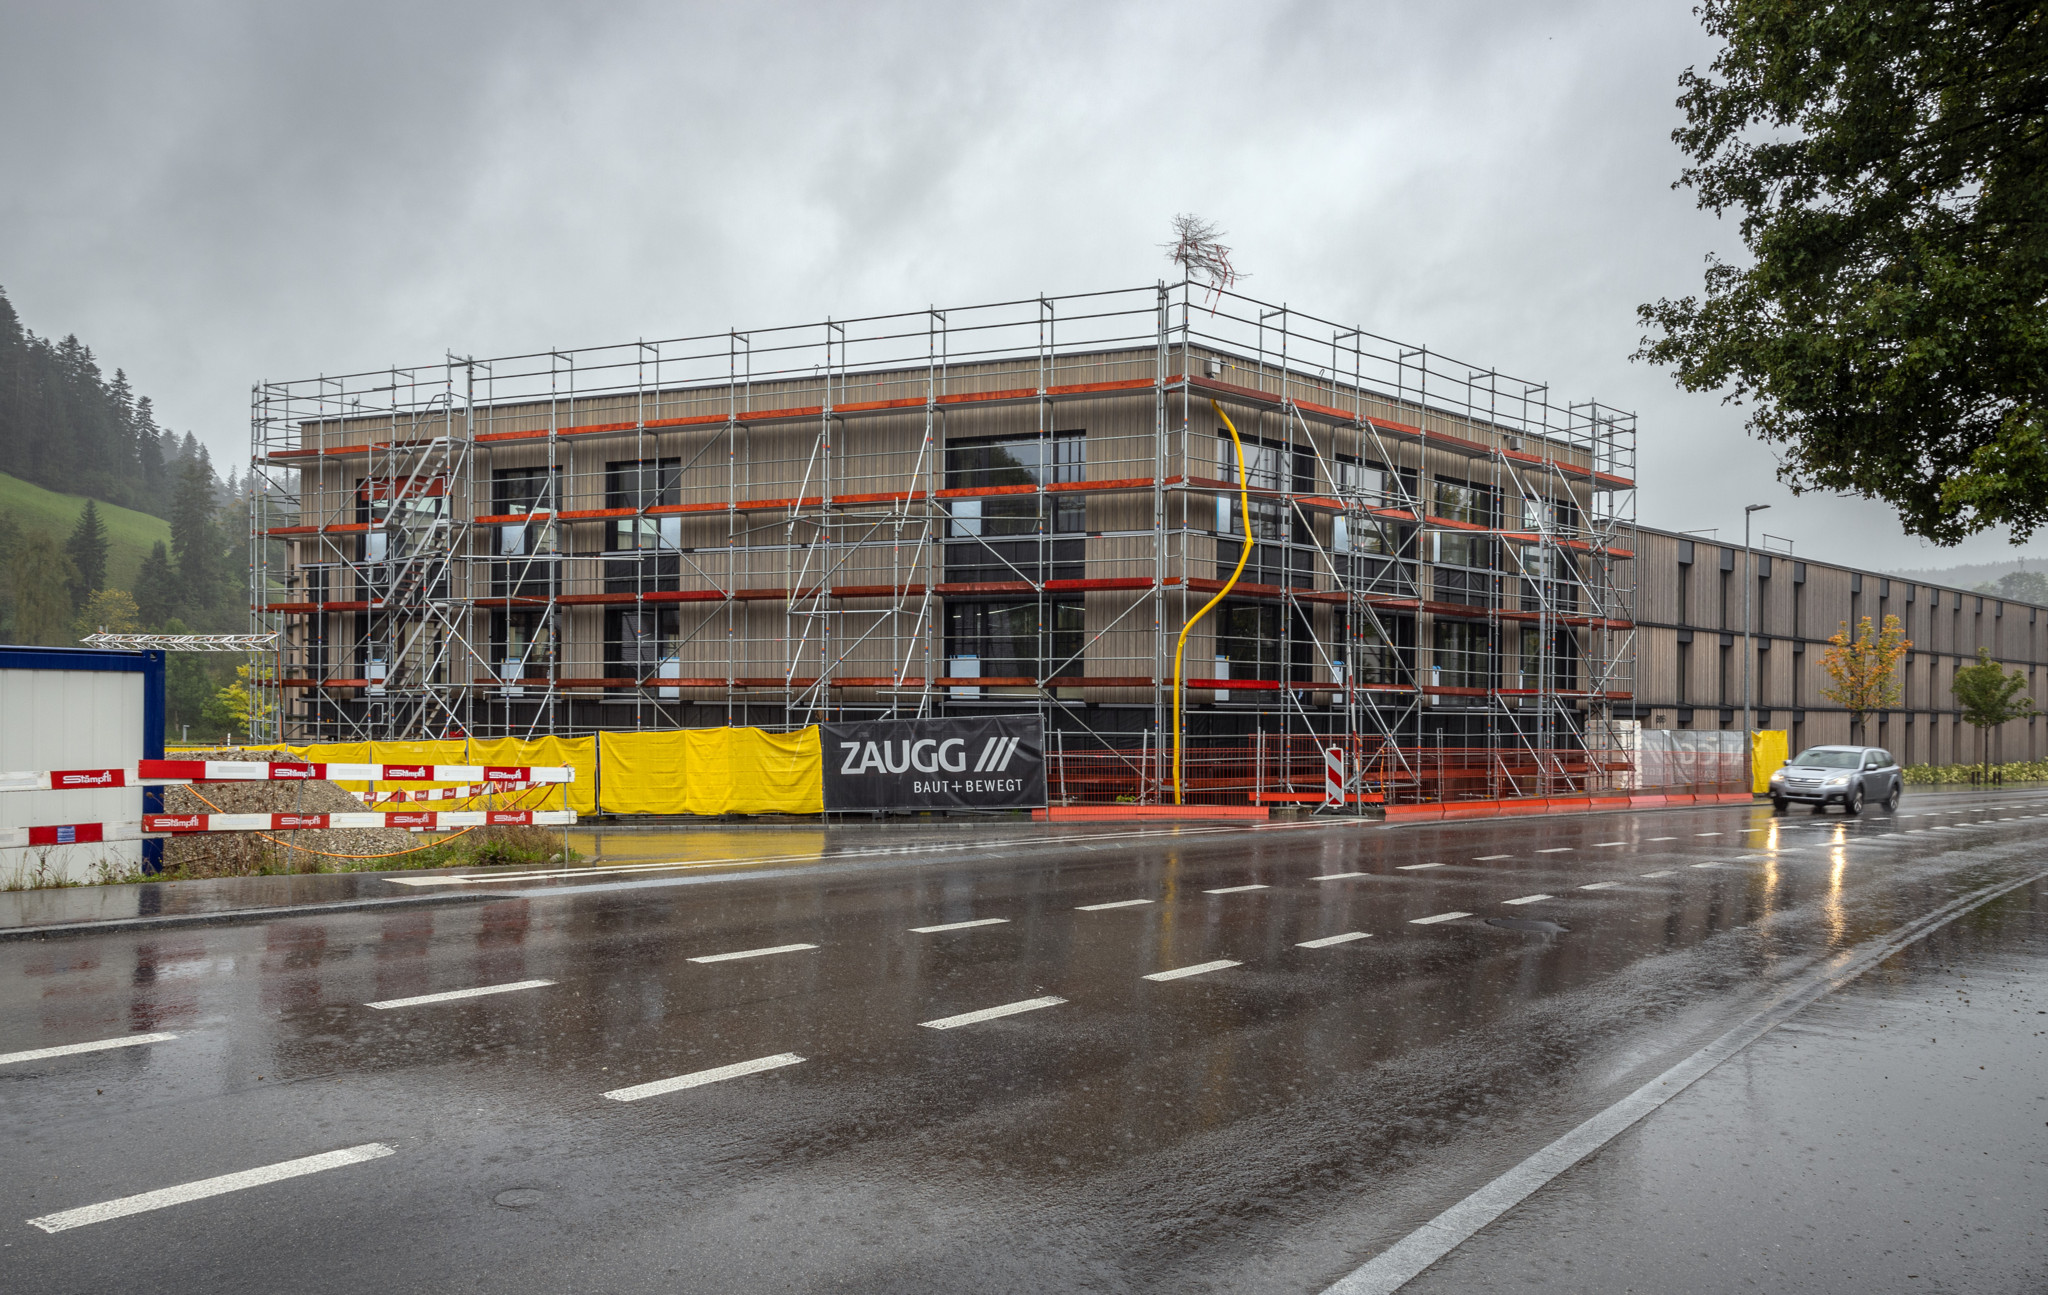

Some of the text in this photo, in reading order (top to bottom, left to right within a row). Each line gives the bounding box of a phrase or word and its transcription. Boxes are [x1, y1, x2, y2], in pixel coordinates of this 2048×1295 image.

[840, 738, 967, 775] ZAUGG
[62, 770, 112, 785] Stämpfli
[274, 765, 316, 779] Stämpli
[913, 778, 1023, 794] BAUT+BEWEGT
